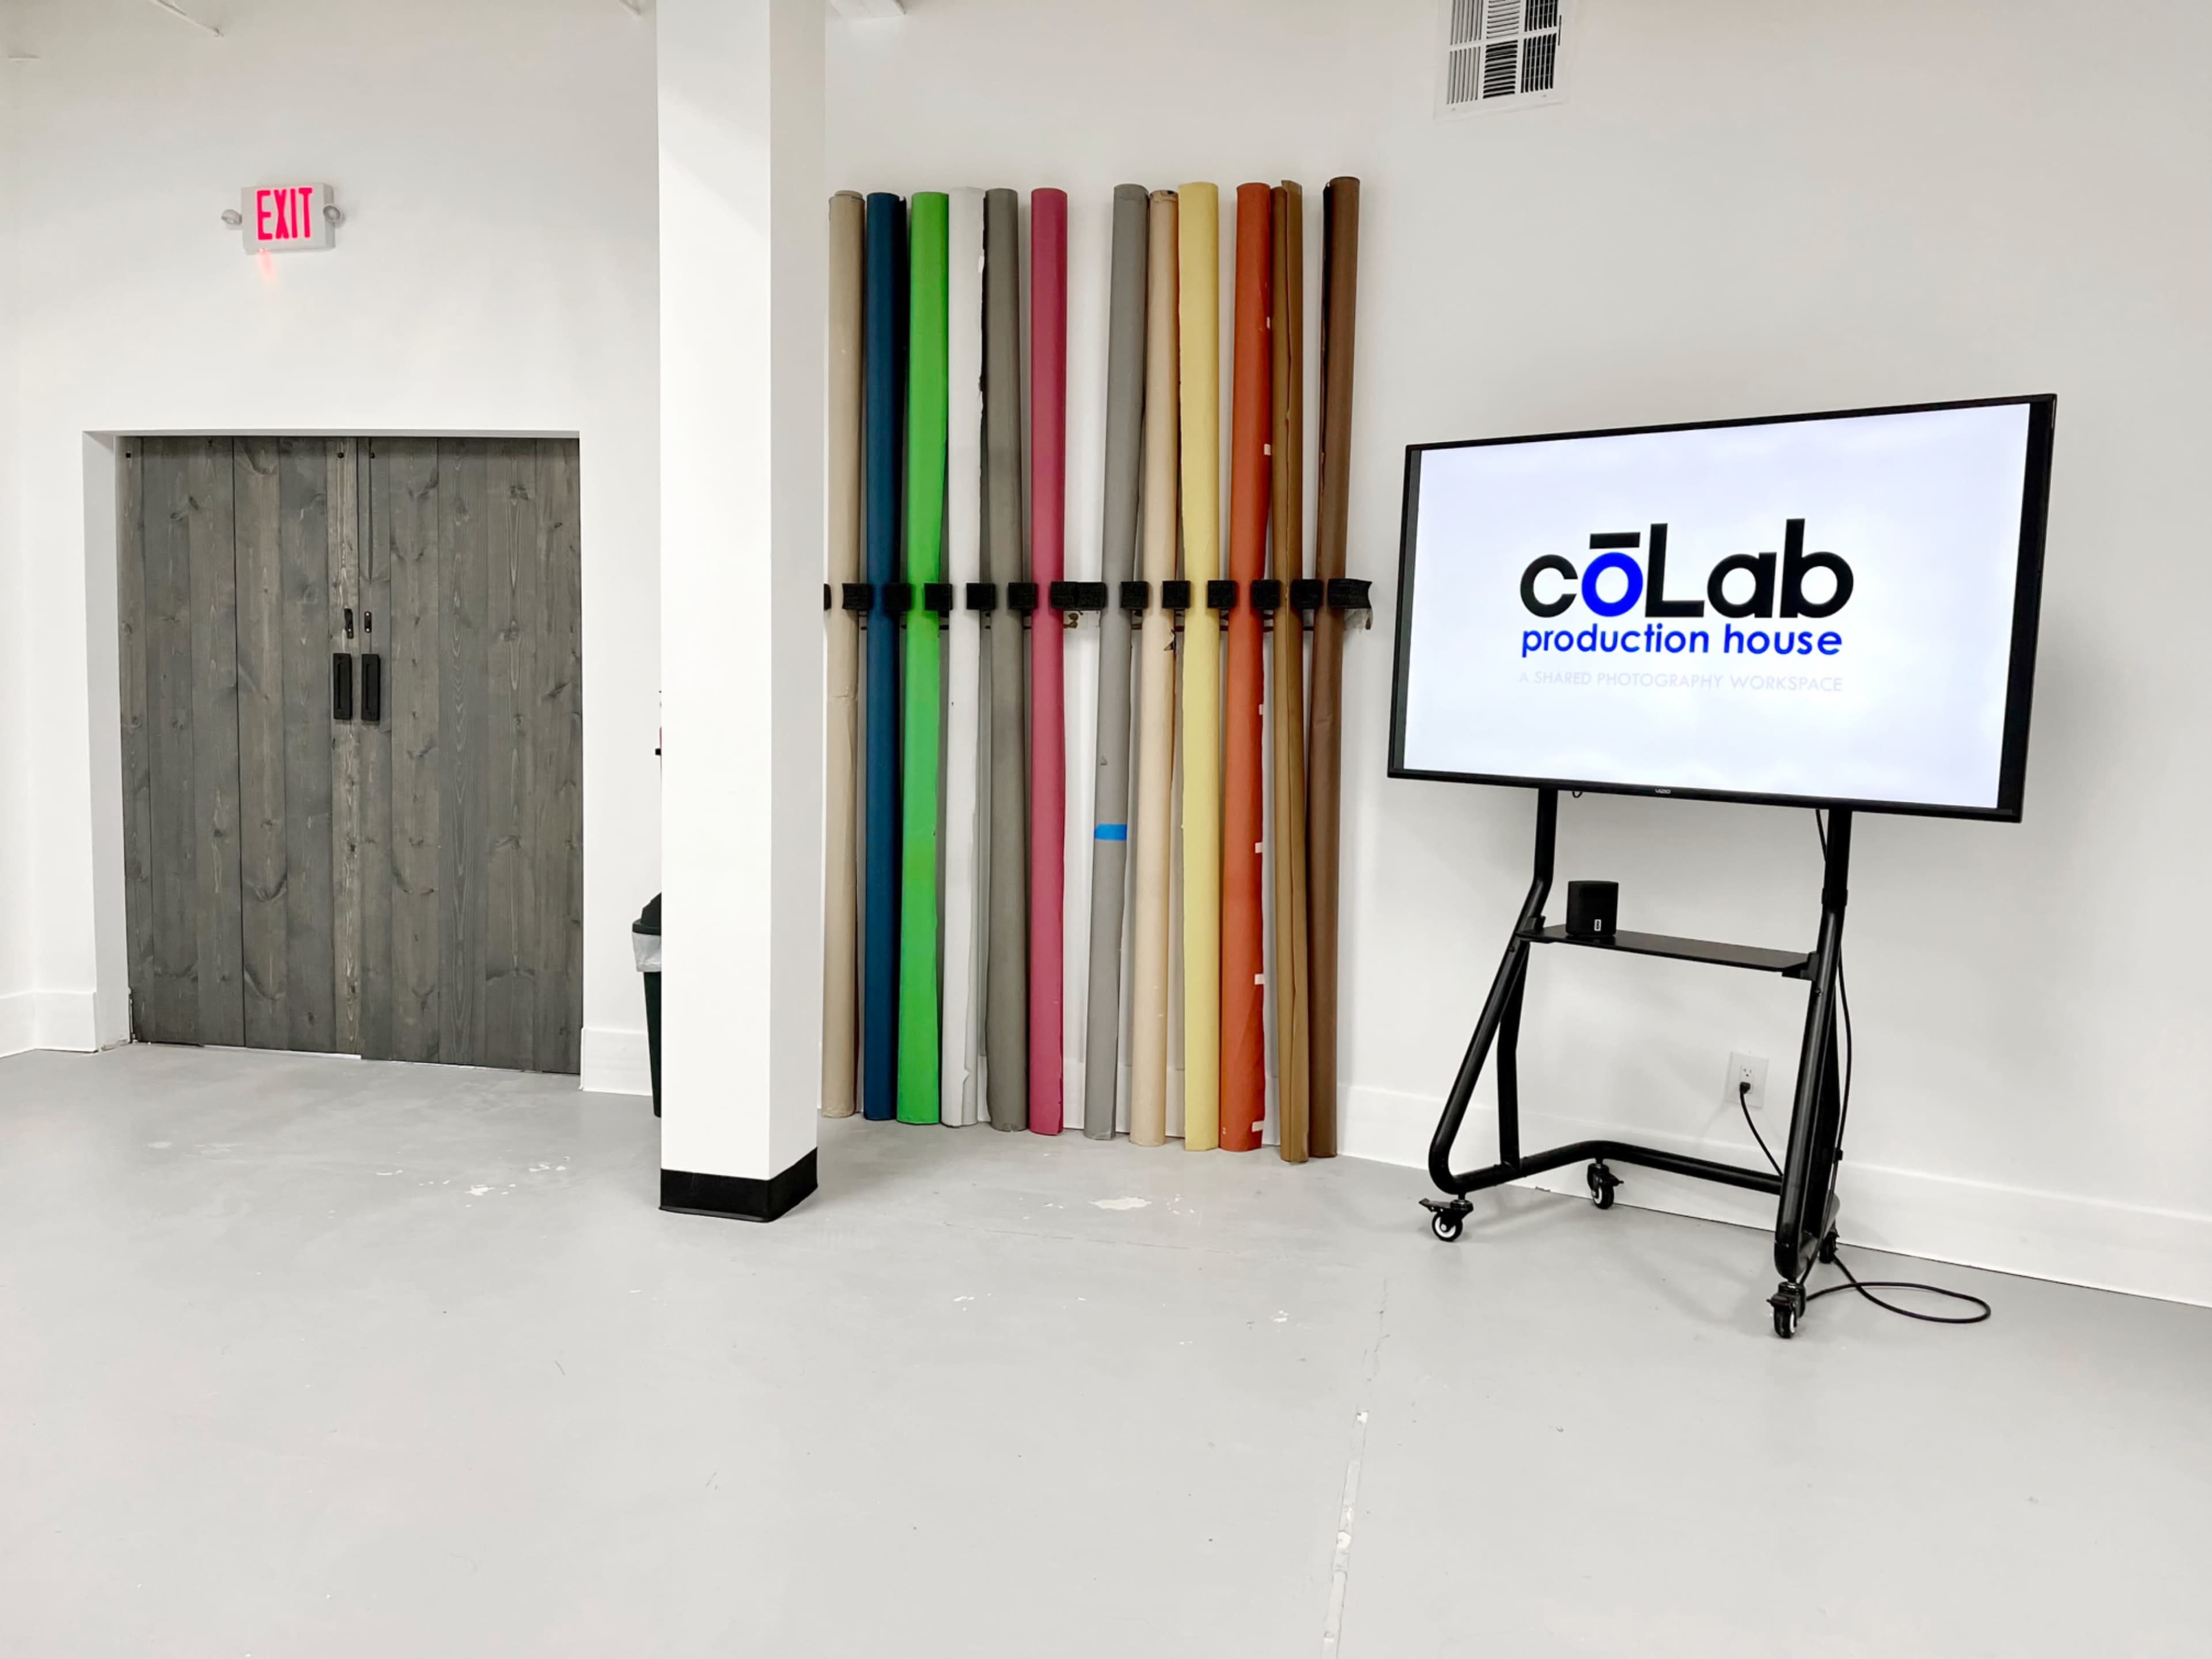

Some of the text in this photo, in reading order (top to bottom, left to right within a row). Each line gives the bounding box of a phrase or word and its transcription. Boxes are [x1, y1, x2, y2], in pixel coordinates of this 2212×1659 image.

[256, 186, 313, 241] EXIT
[1521, 623, 1842, 658] production house
[1518, 671, 1843, 692] A SHARED PHOTOGRAPHY WORKSPACE
